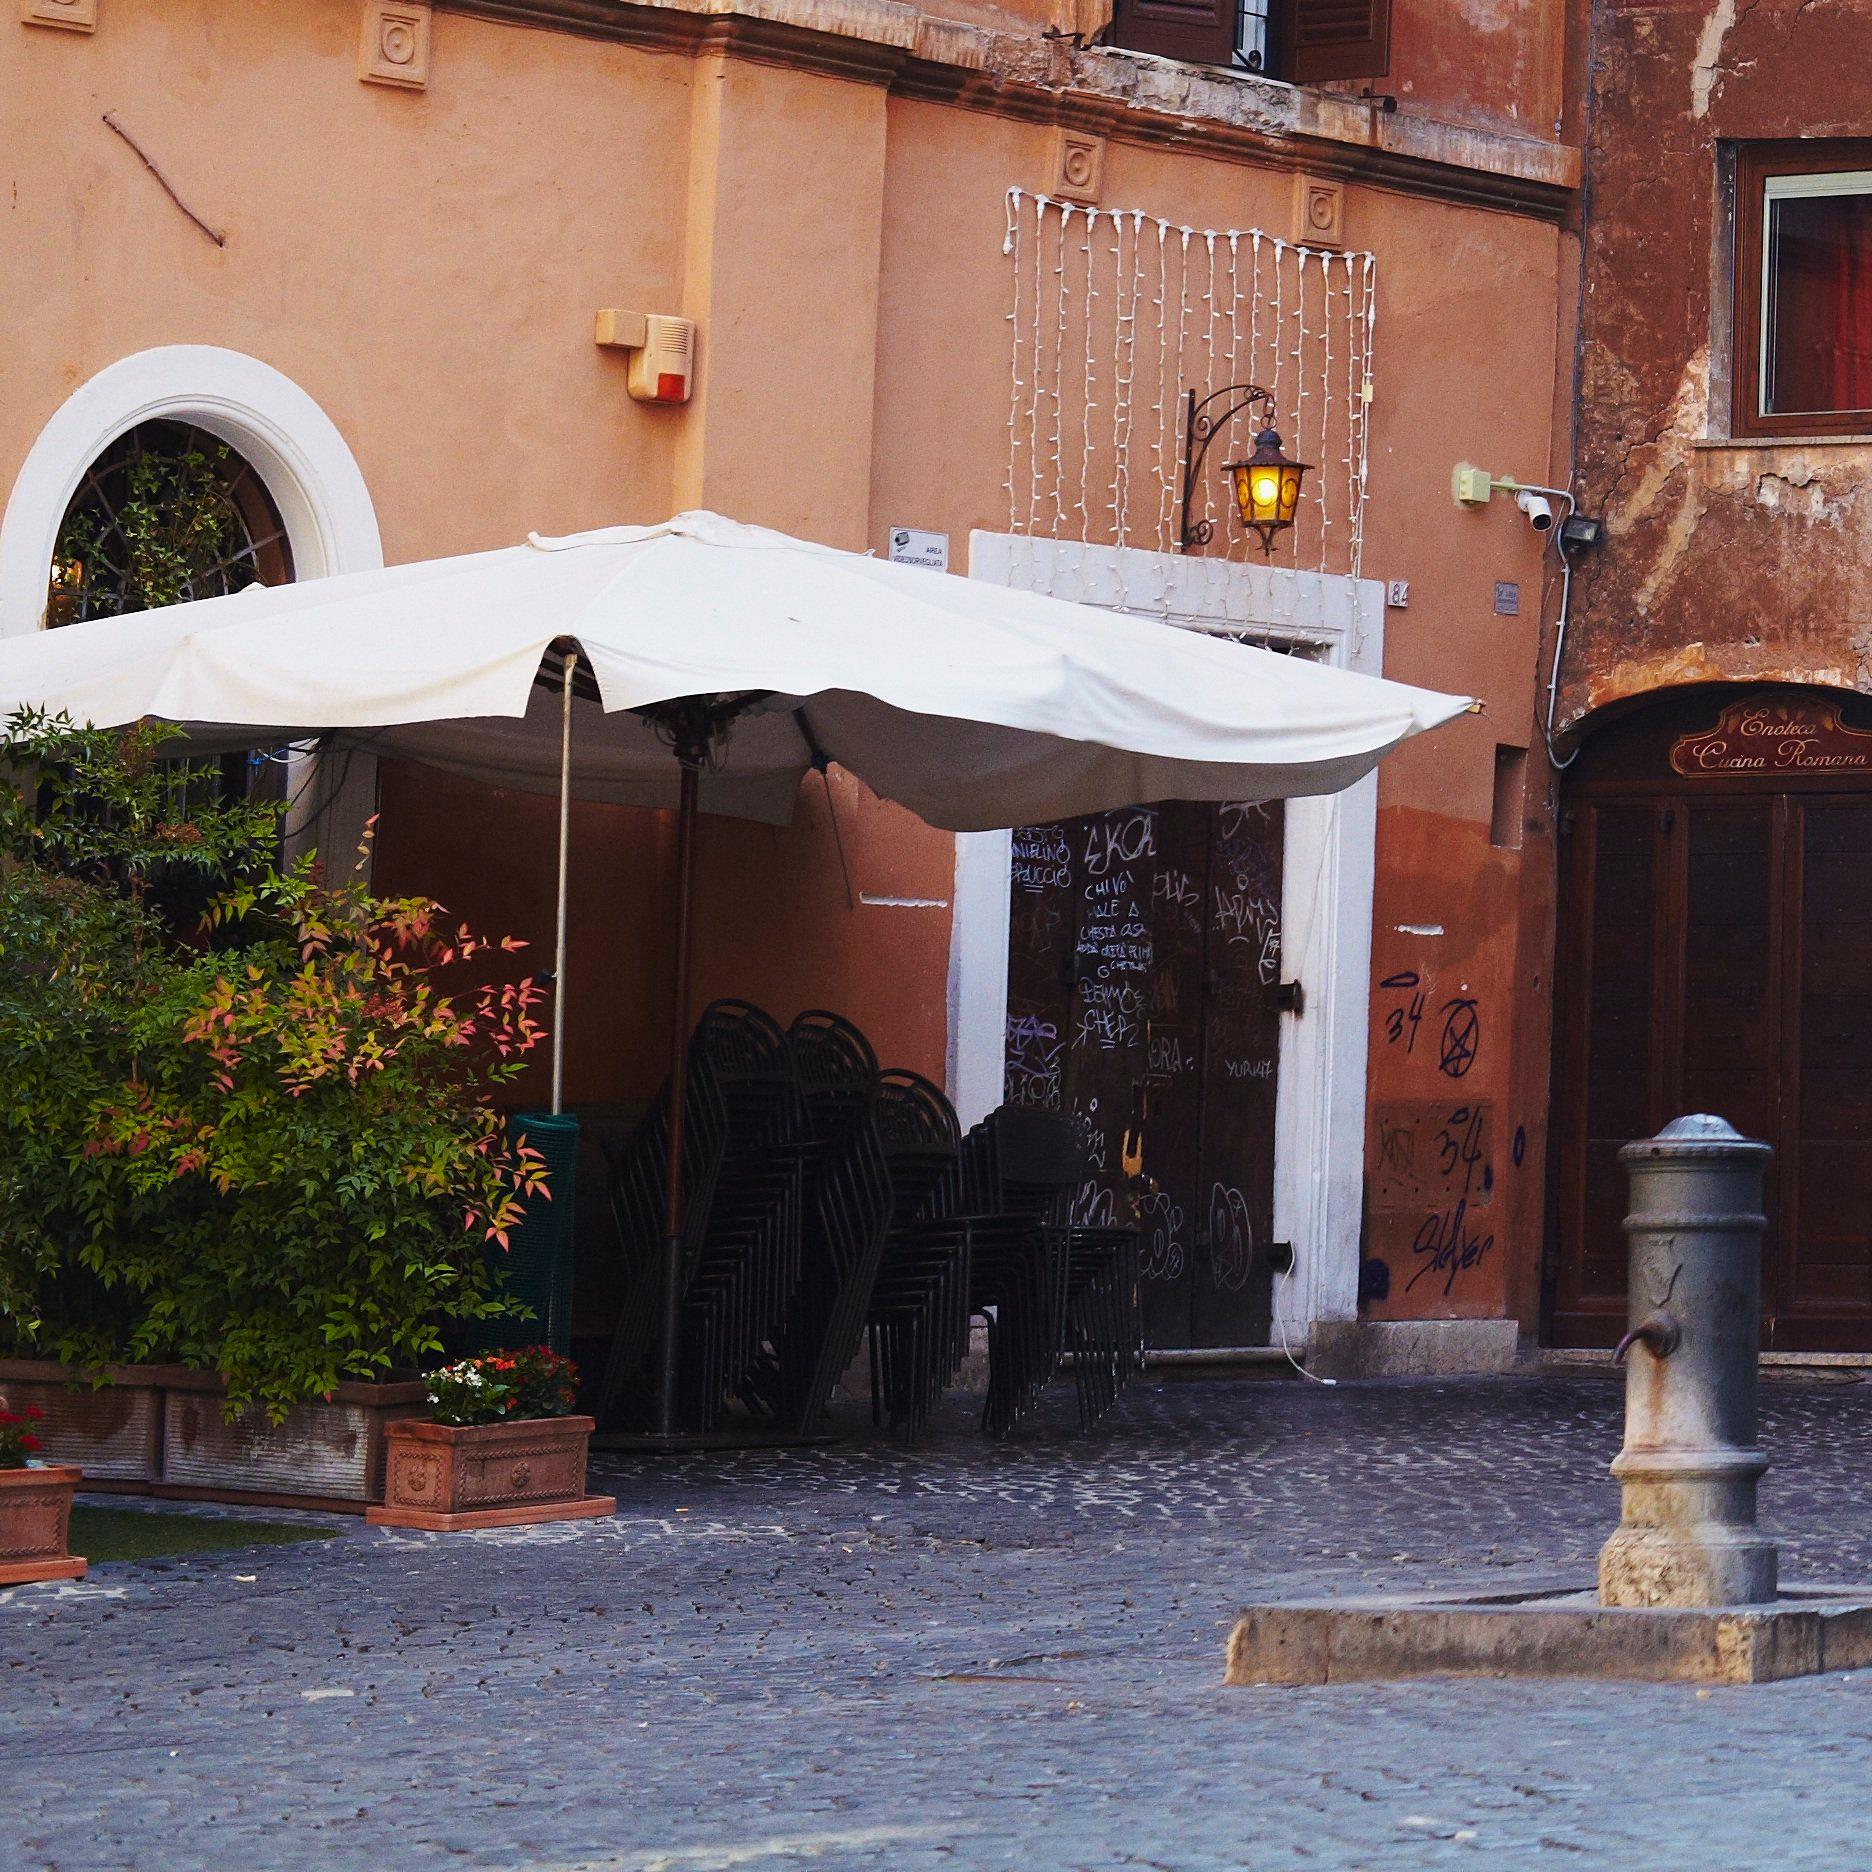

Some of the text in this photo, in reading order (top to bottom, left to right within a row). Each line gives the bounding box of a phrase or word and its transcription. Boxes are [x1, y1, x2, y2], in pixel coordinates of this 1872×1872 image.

[1741, 708, 1817, 737] Enoteca
[1693, 739, 1869, 769] Cucina Romana
